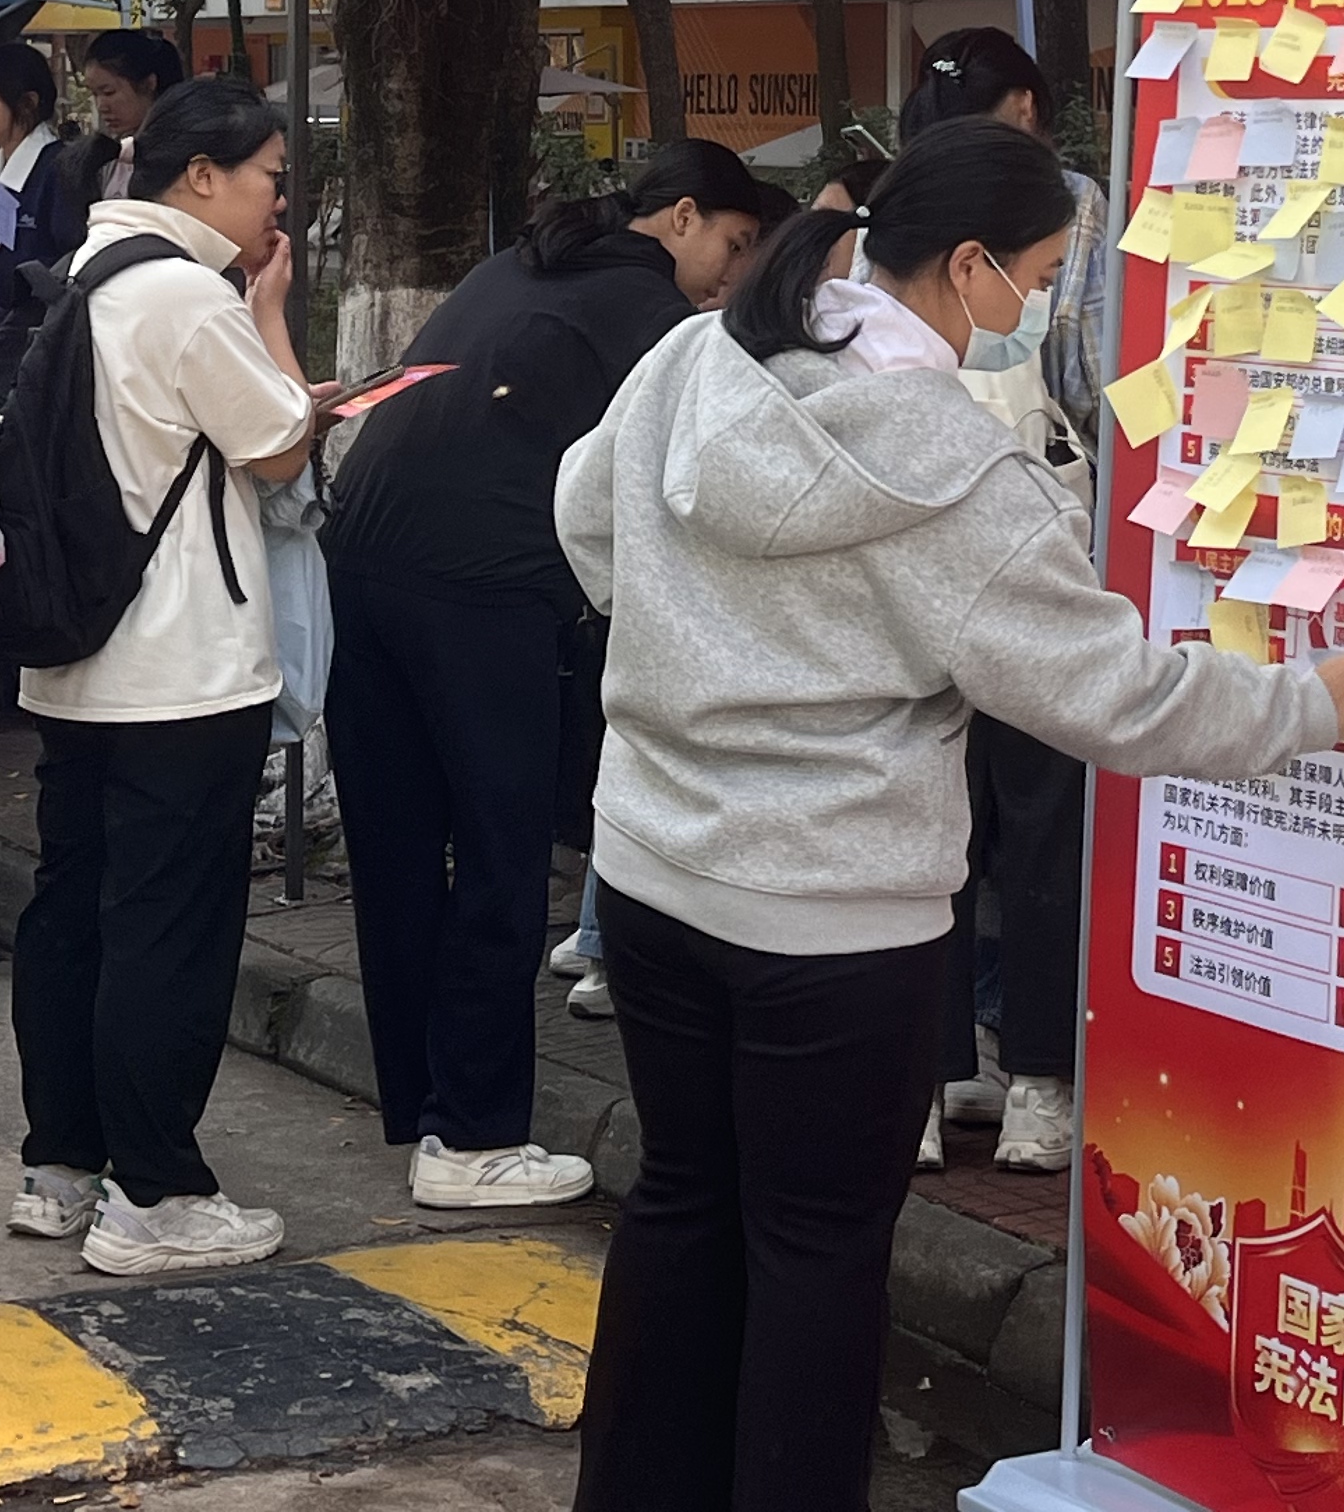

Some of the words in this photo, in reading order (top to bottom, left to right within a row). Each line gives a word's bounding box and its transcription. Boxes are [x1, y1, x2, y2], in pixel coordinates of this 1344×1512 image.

[683, 73, 739, 115] HELLO
[748, 73, 818, 117] SUNSHI
[1186, 440, 1196, 457] 5
[1168, 852, 1178, 874] 1
[1194, 859, 1277, 902] 权利保障价值
[1164, 899, 1176, 921] 3
[1192, 907, 1274, 950] 秩序维护价值
[1162, 946, 1175, 968] 5
